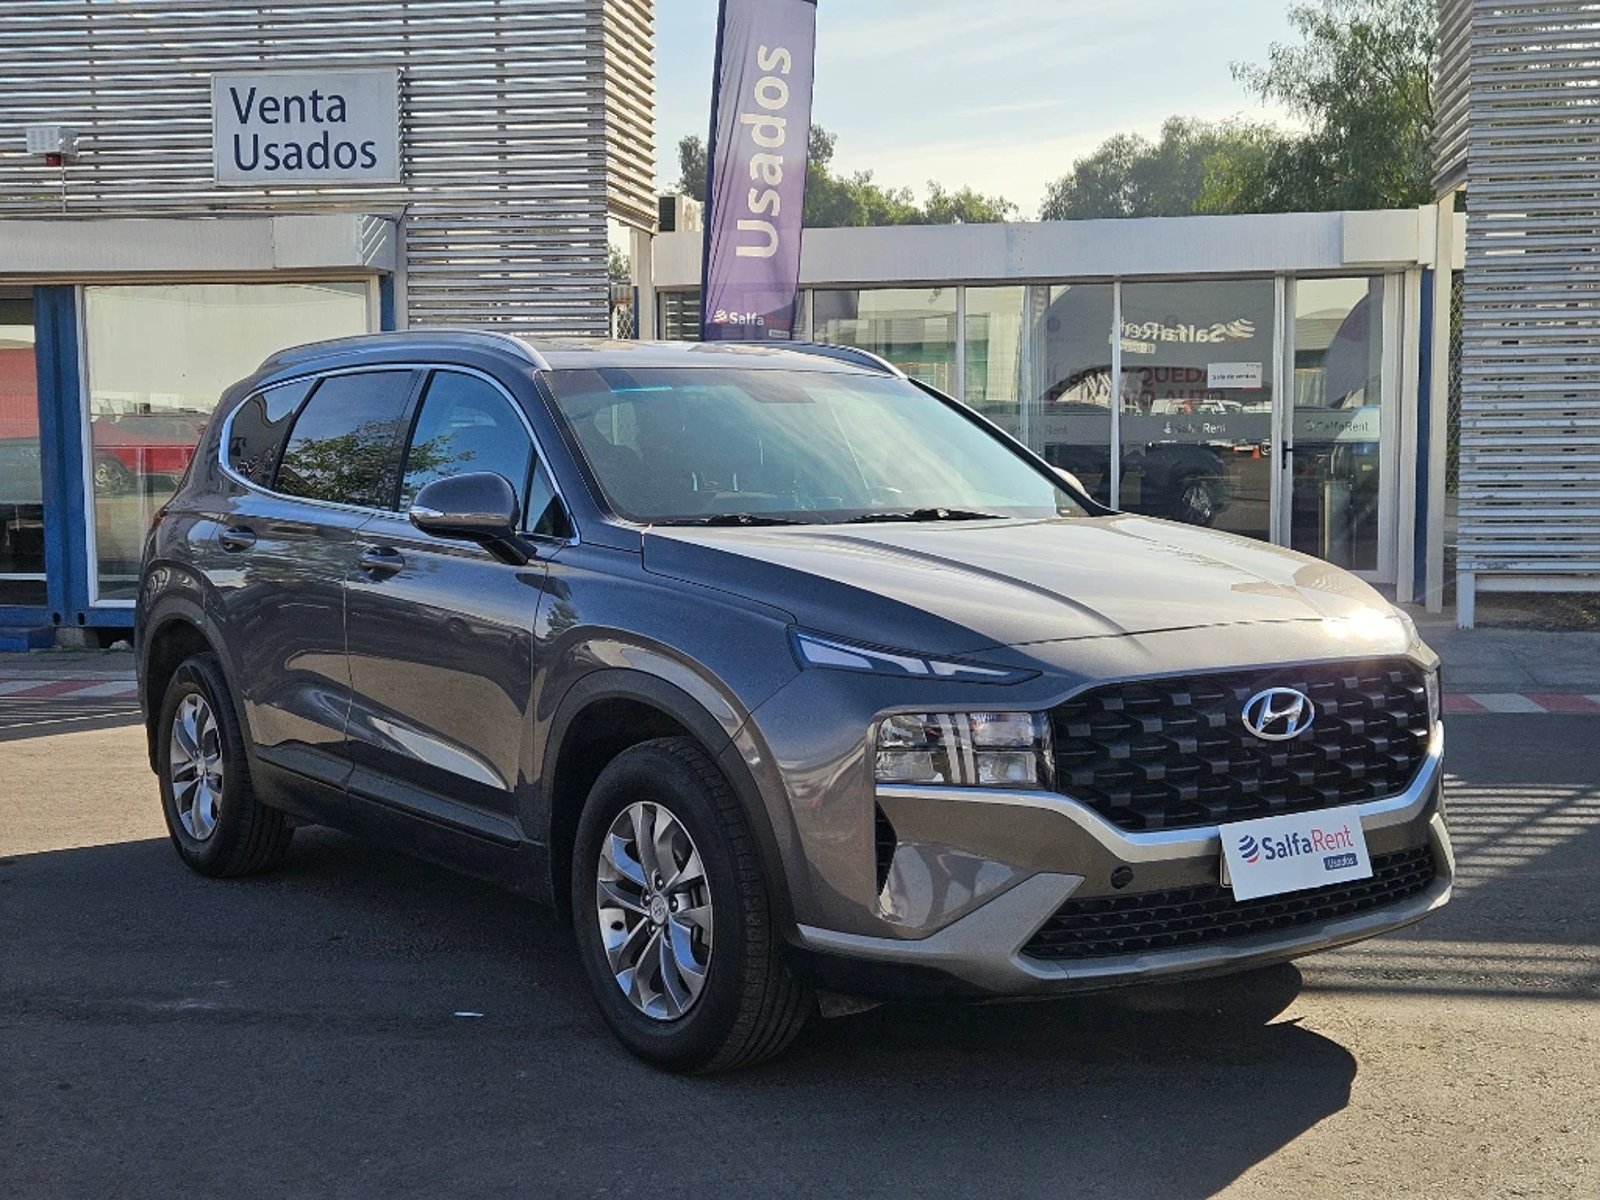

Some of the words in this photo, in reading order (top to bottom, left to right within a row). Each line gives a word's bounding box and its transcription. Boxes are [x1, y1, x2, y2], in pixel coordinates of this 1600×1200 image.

[229, 86, 347, 124] Venta
[233, 130, 377, 171] Usados
[736, 45, 792, 258] Usados
[1261, 825, 1354, 860] SalfaRent
